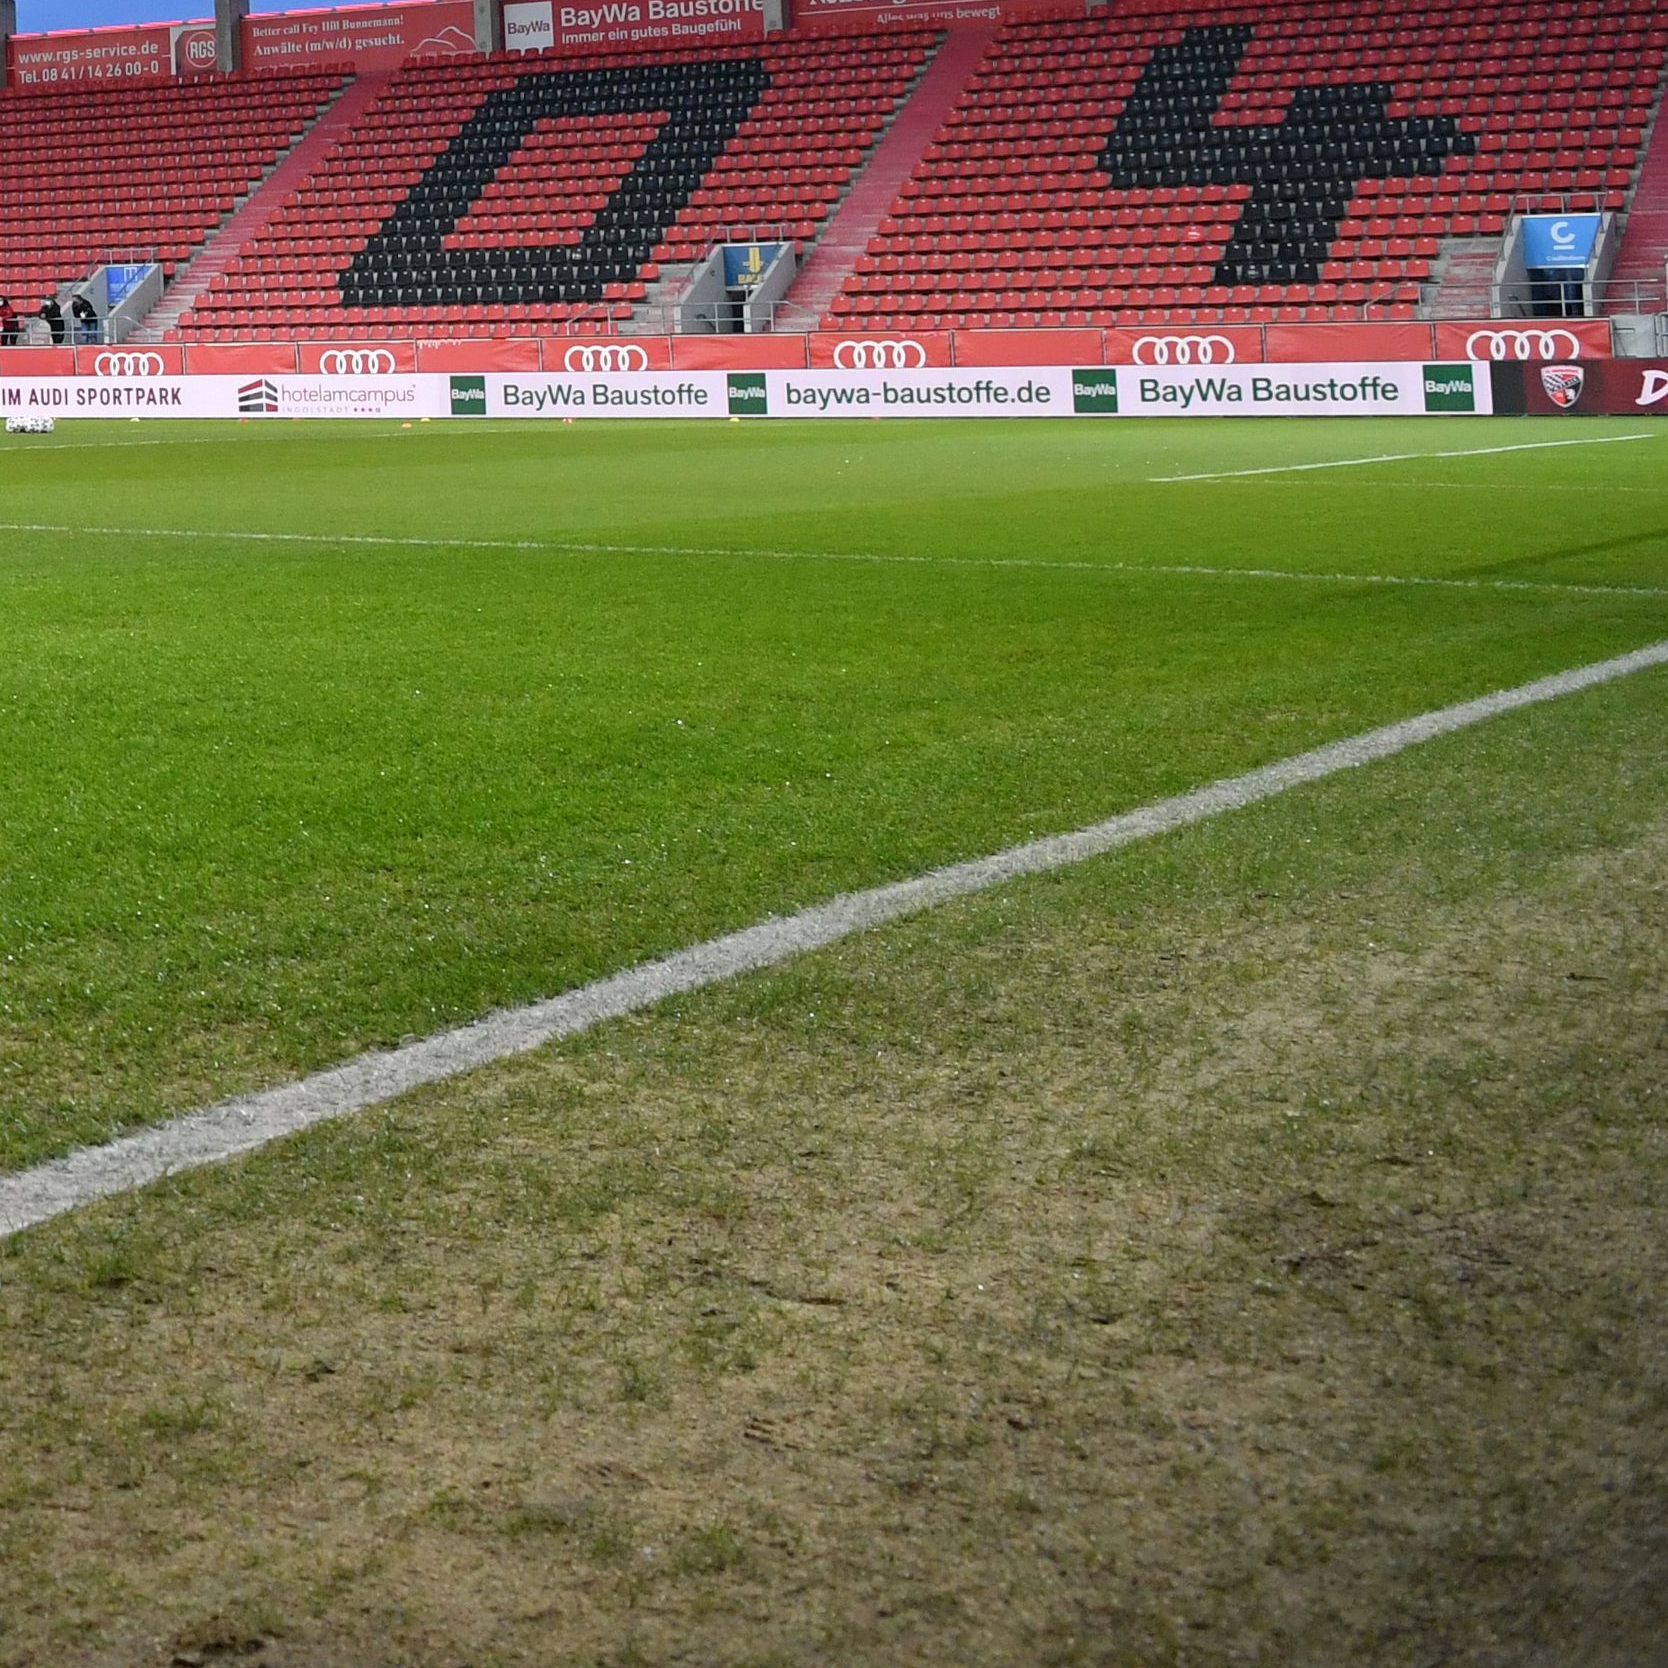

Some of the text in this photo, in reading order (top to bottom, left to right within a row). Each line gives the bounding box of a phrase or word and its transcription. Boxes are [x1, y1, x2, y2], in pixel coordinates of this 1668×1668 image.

[560, 1, 640, 28] BayWa
[956, 5, 1001, 20] bewegt
[252, 26, 280, 38] Better
[283, 24, 300, 35] call
[507, 20, 551, 35] BayWa
[562, 19, 742, 45] Immer ein gutes Baugefühl
[18, 40, 159, 64] www.rgs-service.de
[190, 41, 215, 59] RGS
[254, 33, 405, 56] Anwälte (m/w/d) gesucht.
[106, 64, 122, 77] 26
[29, 387, 69, 406] AUDI
[76, 387, 182, 406] SPORTPARK
[451, 388, 486, 401] BayWa
[503, 383, 708, 410] BayWa Baustoffe
[729, 386, 765, 399] BayWa
[786, 380, 1051, 410] baywa-baustoffe.de
[1074, 384, 1117, 397] BayWa
[1140, 376, 1399, 409] BayWa Baustoffe
[1425, 380, 1472, 395] BayWa
[281, 383, 414, 411] hotelamcampus
